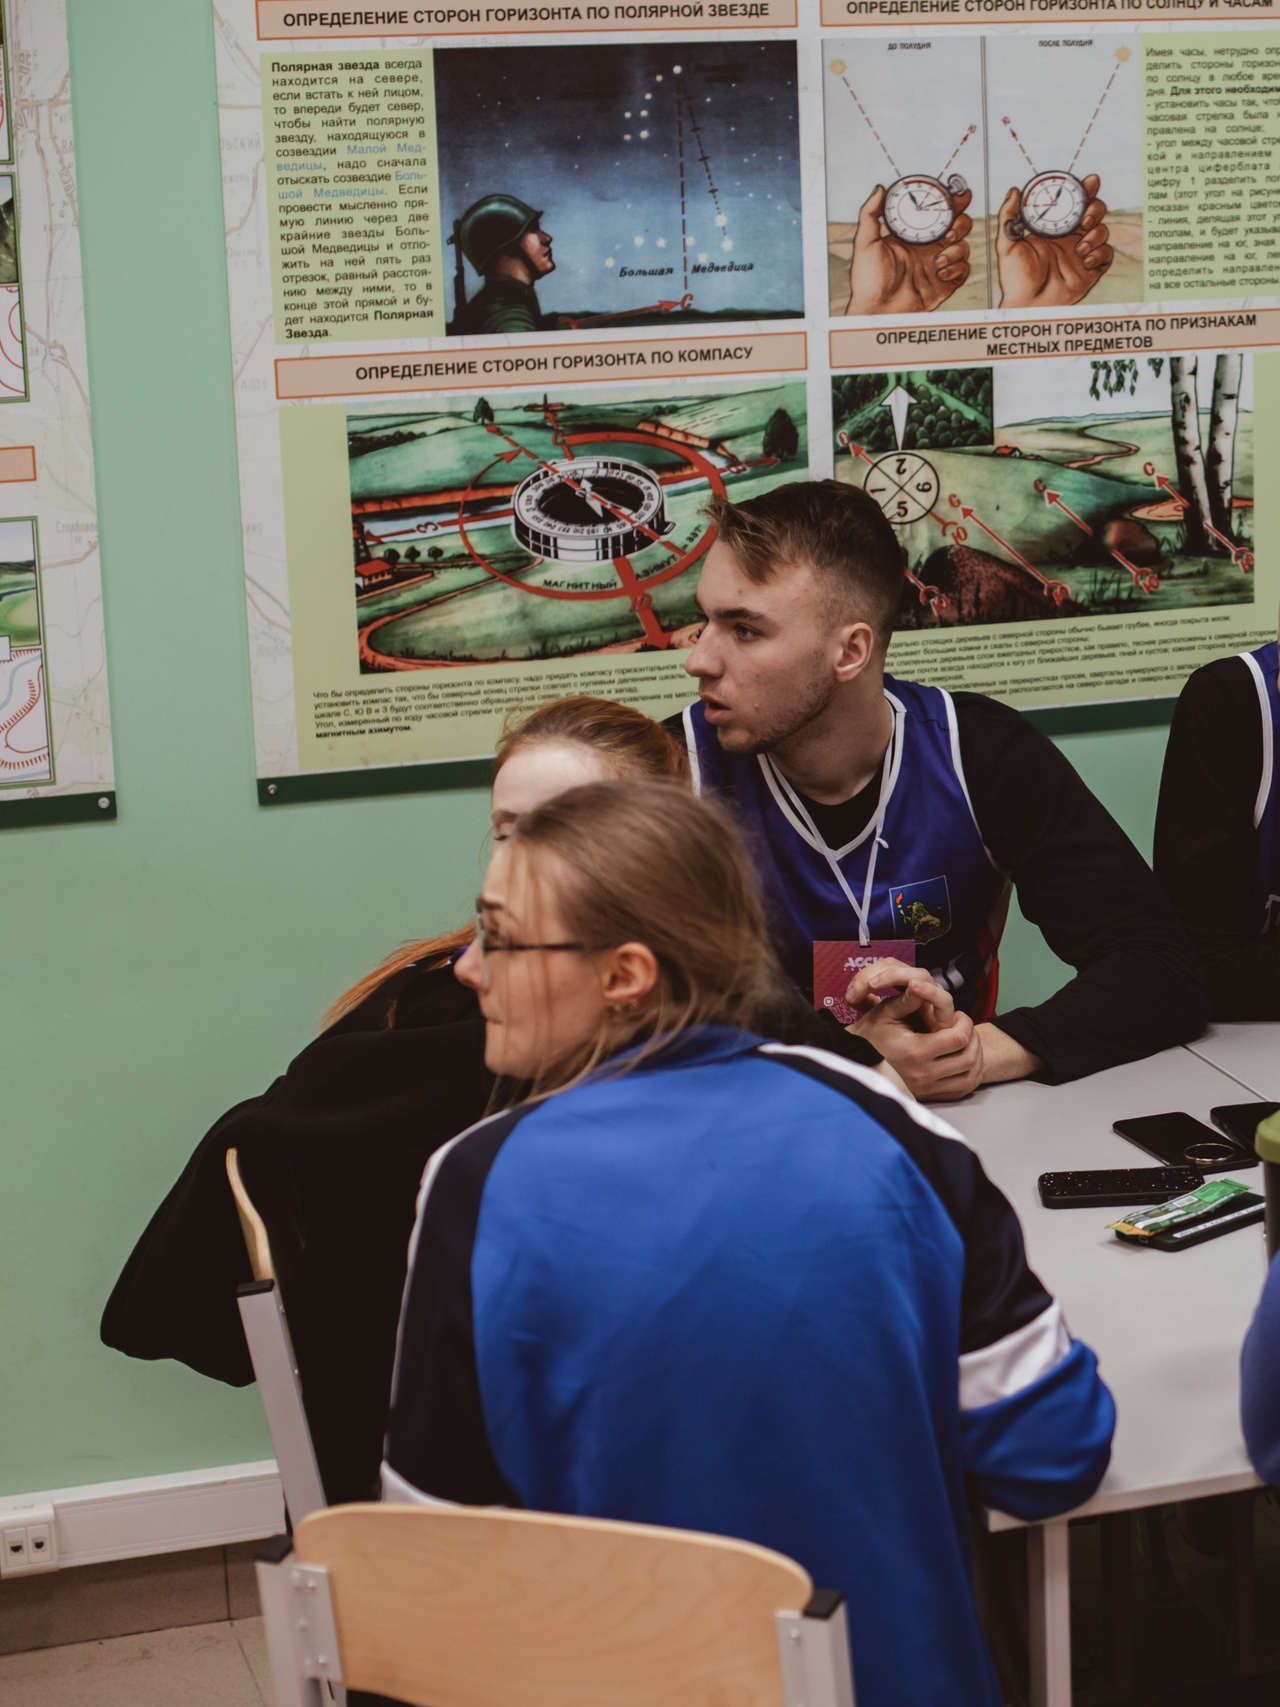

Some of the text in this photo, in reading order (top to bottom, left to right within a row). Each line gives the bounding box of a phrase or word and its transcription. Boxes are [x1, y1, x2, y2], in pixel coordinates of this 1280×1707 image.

[282, 1, 769, 28] ОПРЕДЕЛЕНИЕ СТОРОН ГОРИЗОНТА ПО ПОЛЯРНОЙ ЗВЕЗДЕ
[846, 0, 960, 16] ОПРЕДЕЛЕНИЕ
[964, 0, 1025, 12] СТОРОН
[1030, 0, 1117, 11] ГОРИЗОНТА
[1120, 0, 1142, 10] ПО
[1145, 0, 1204, 10] СОЛНЦУ
[1208, 0, 1218, 8] И
[271, 60, 422, 74] Полярная звезда всегда
[272, 73, 422, 87] находится на севере,
[272, 87, 423, 101] если встать к ней лицом,
[273, 101, 424, 116] то впереди будет север,
[273, 115, 425, 129] чтобы найти полярную
[274, 129, 425, 145] звезду, находящуюся в
[275, 142, 425, 158] созвездии Малой Мед-
[276, 157, 426, 172] ведицы, надо сначала
[276, 170, 426, 186] отыскать созвездие Боль-
[277, 183, 428, 200] шой Медведицы. Если
[278, 199, 428, 215] провести мысленно пря-
[279, 213, 429, 230] мую линию через две
[280, 225, 430, 243] крайние звезды Боль-
[280, 240, 430, 255] шой Медведицы и отло-
[281, 254, 431, 269] жить на ней пять раз
[619, 261, 754, 278] Большая Медведица
[281, 268, 432, 285] отрезок, равный расстоя-
[282, 282, 432, 297] нию между ними, то в
[283, 293, 433, 312] конце этой прямой и бу-
[680, 293, 694, 310] С
[284, 309, 434, 327] дет находится Полярная
[285, 328, 331, 339] Звезда.
[876, 313, 1256, 345] ОПРЕДЕЛЕНИЕ СТОРОН ГОРИЗОНТА ПО ПРИЗНАКАМ
[986, 335, 1153, 356] МЕСТНЫХ ПРЕДМЕТОВ
[355, 346, 752, 380] ОПРЕДЕЛЕНИЕ СТОРОН ГОРИЗОНТА ПО КОМПАСУ
[543, 578, 618, 590] МАГНИТНЫЙ
[635, 555, 678, 581] АЗИМУТ
[315, 725, 411, 738] магнитным азимутом.
